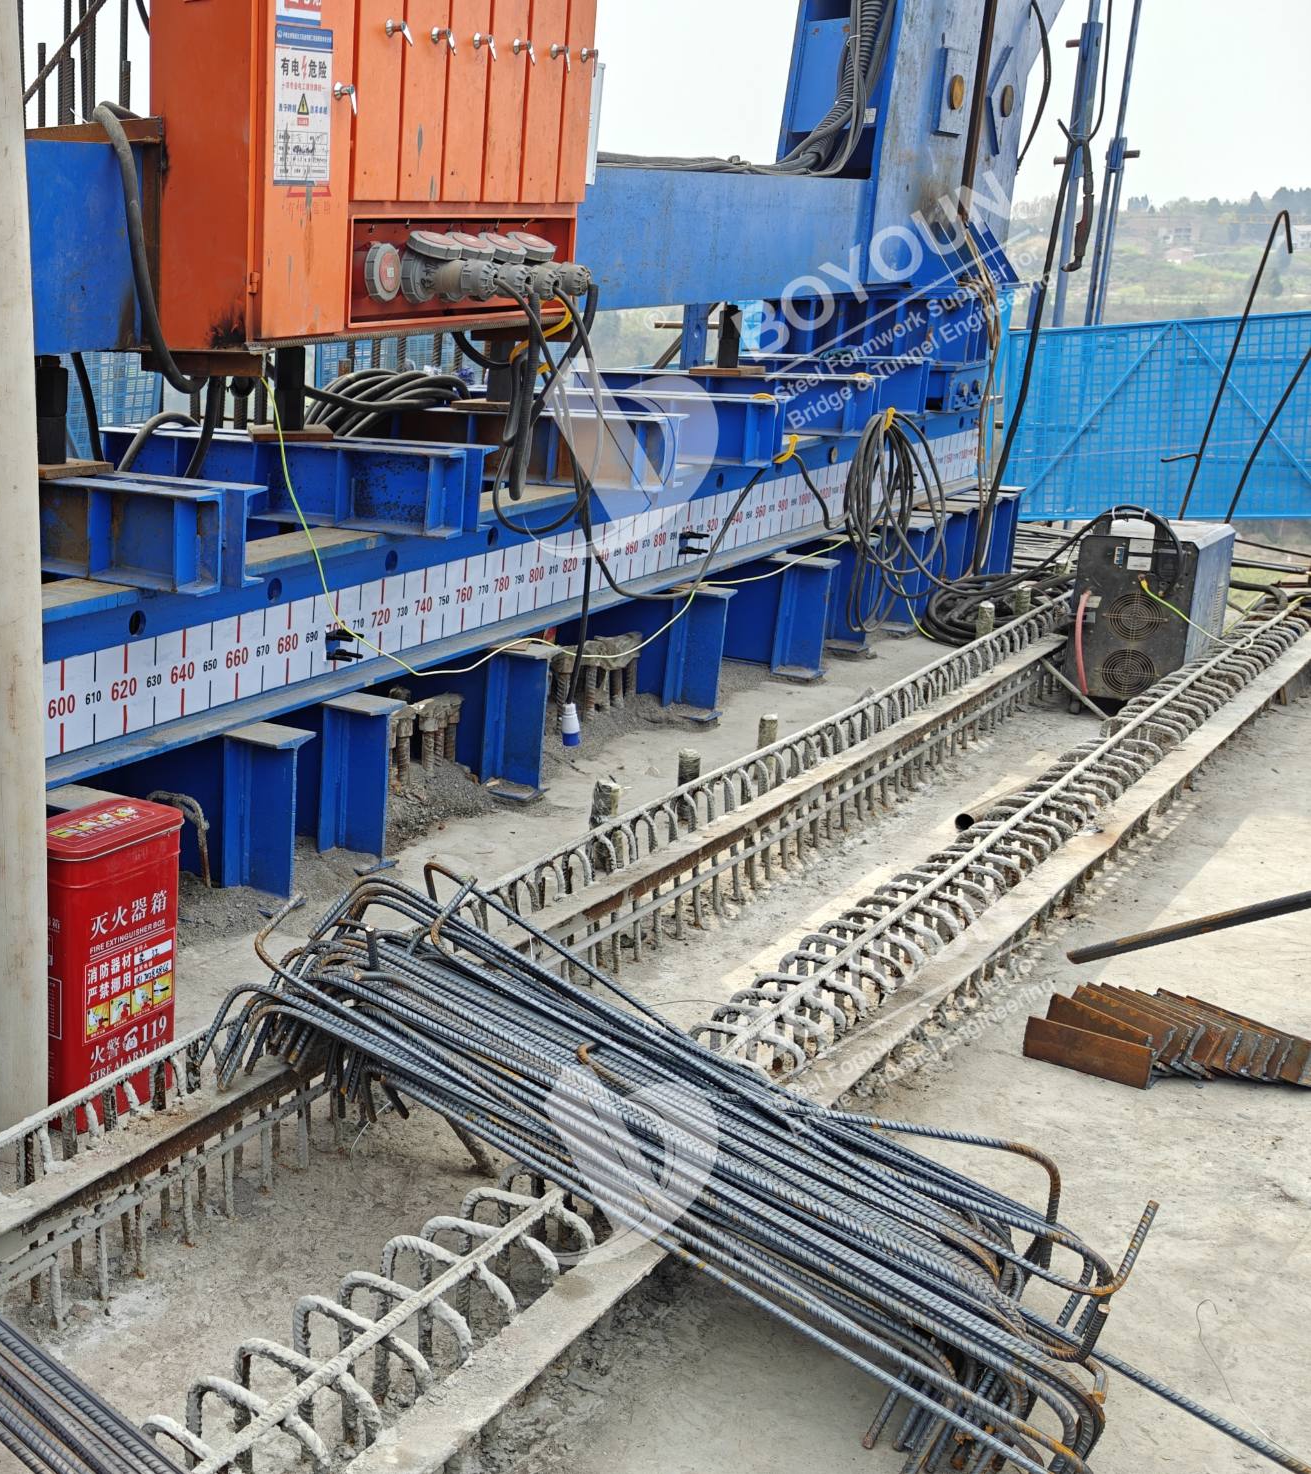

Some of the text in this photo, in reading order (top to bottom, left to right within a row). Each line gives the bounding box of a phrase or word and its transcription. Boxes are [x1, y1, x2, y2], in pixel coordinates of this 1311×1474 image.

[280, 57, 327, 79] 有电 危险
[48, 694, 76, 720] 600
[86, 690, 102, 706] 610
[111, 677, 137, 701] 620
[146, 674, 162, 688] 630
[170, 662, 195, 685] 640
[203, 658, 218, 672] 650
[226, 647, 248, 669] 660
[256, 644, 270, 657] 670
[277, 633, 299, 654] 680
[305, 630, 319, 644] 690
[352, 618, 364, 630] 710
[371, 608, 390, 628] 720
[397, 606, 408, 618] 730
[415, 596, 433, 616] 740
[438, 594, 450, 606] 750
[456, 586, 473, 604] 760
[478, 584, 489, 595] 770
[494, 576, 510, 594] 780
[514, 574, 524, 585] 790
[528, 566, 544, 583] 800
[548, 564, 558, 576] 810
[562, 557, 578, 574] 820
[625, 540, 638, 556] 860
[653, 532, 667, 548] 880
[706, 518, 718, 532] 920
[755, 504, 766, 518] 960
[90, 890, 167, 940] 灭火器箱
[90, 943, 104, 954] FIRE
[106, 924, 152, 948] EXTINGUISHER
[88, 952, 132, 984] 消防器材
[87, 972, 132, 1005] 严禁挪用
[90, 1036, 120, 1070] 火警
[142, 1016, 167, 1044] 119
[90, 1064, 112, 1082] FIRE
[114, 1048, 148, 1070] ALARM
